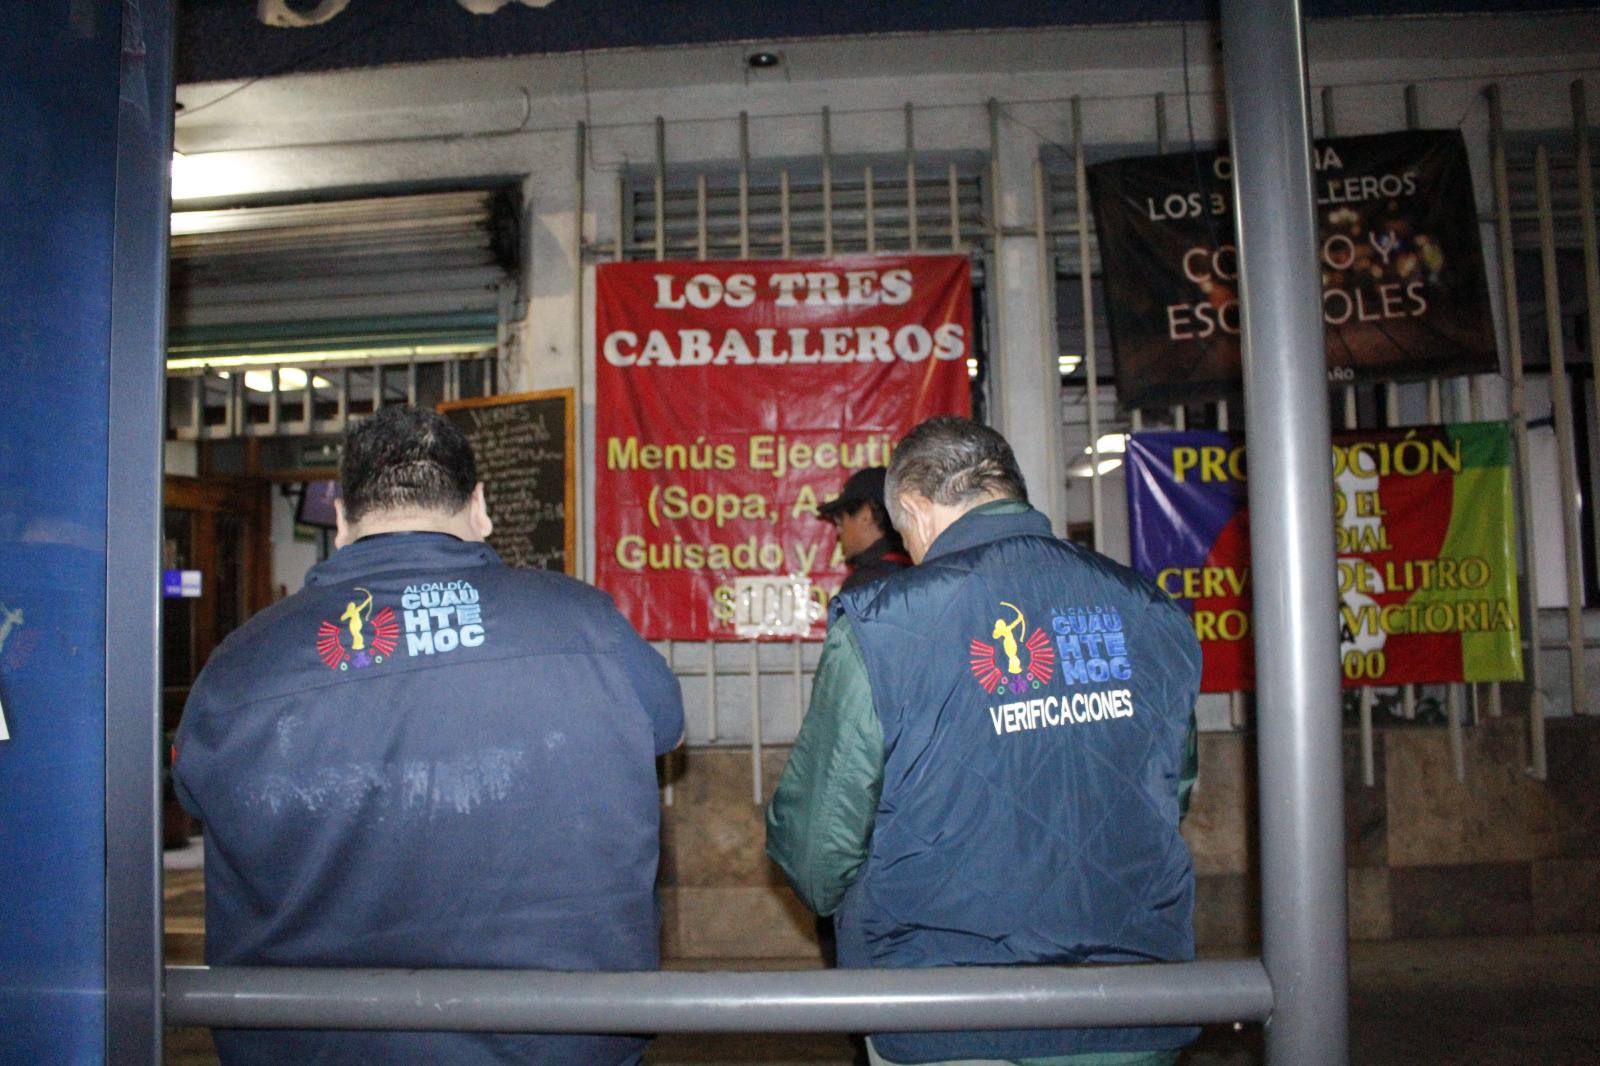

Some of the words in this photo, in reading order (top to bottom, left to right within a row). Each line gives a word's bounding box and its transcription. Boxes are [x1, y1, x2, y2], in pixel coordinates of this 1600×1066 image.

[1148, 192, 1203, 221] LOS
[1210, 193, 1226, 215] 3
[654, 274, 757, 310] LOS
[770, 268, 913, 307] TRES
[602, 324, 966, 367] CABALLEROS
[606, 431, 736, 471] Menús
[749, 433, 898, 478] Ejecuti
[648, 486, 778, 527] (Sopa,
[615, 535, 784, 571] Guisado
[794, 543, 818, 577] y
[403, 580, 473, 594] ALCALDÍA
[1386, 556, 1491, 592] LITRO
[401, 589, 480, 610] CUAU
[403, 603, 483, 633] HTE
[1052, 613, 1123, 635] CUAU
[1341, 600, 1517, 637] VICTORIA
[406, 624, 485, 656] MOC
[1056, 631, 1129, 660] HTE
[1060, 656, 1133, 686] MOC
[989, 688, 1134, 736] VERIFICACIONES
